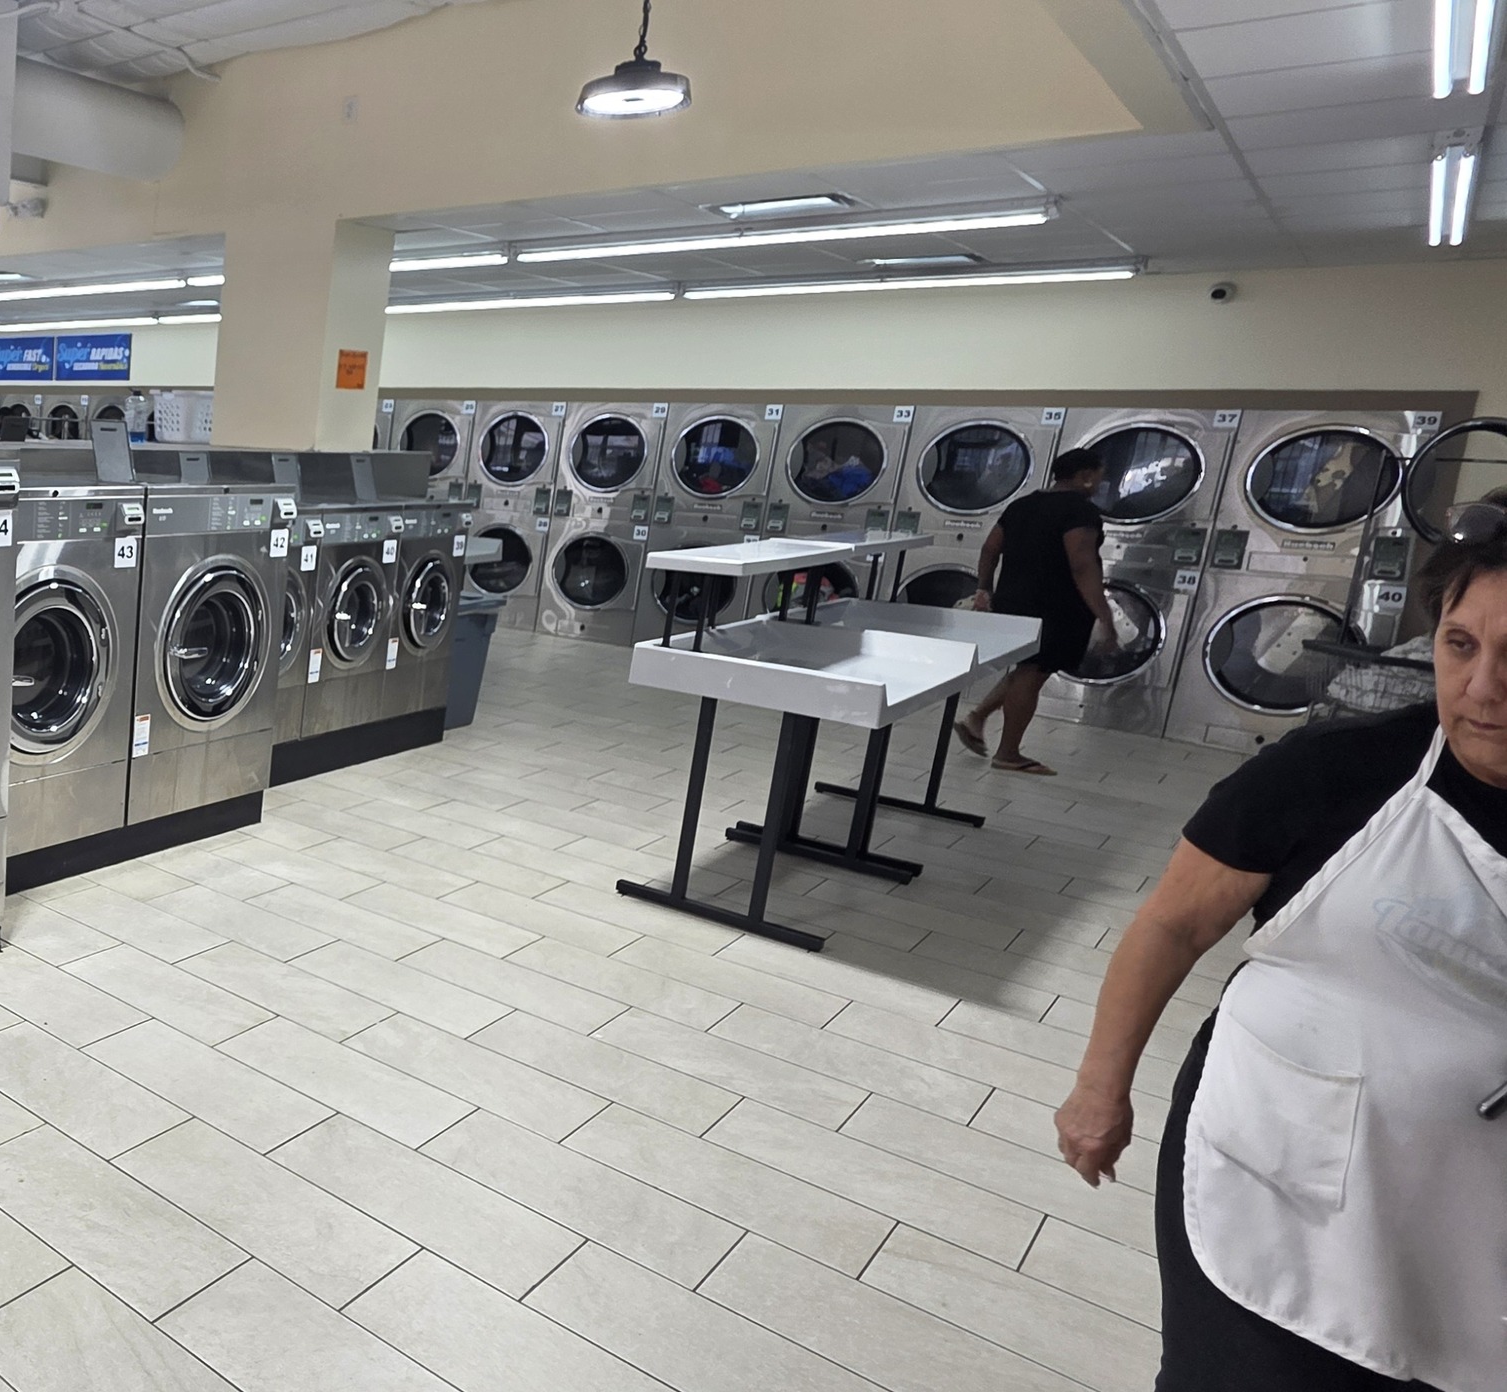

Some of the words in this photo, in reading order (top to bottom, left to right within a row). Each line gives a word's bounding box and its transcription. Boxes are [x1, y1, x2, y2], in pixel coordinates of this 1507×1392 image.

[23, 349, 43, 362] FAST
[57, 343, 90, 367] Super
[768, 408, 780, 416] 31
[896, 409, 911, 418] 33
[1217, 413, 1237, 423] 37
[1415, 416, 1437, 425] 39
[636, 529, 647, 537] 30
[273, 537, 286, 548] 42
[118, 545, 134, 559] 43
[304, 553, 314, 563] 41
[1379, 592, 1403, 602] 40
